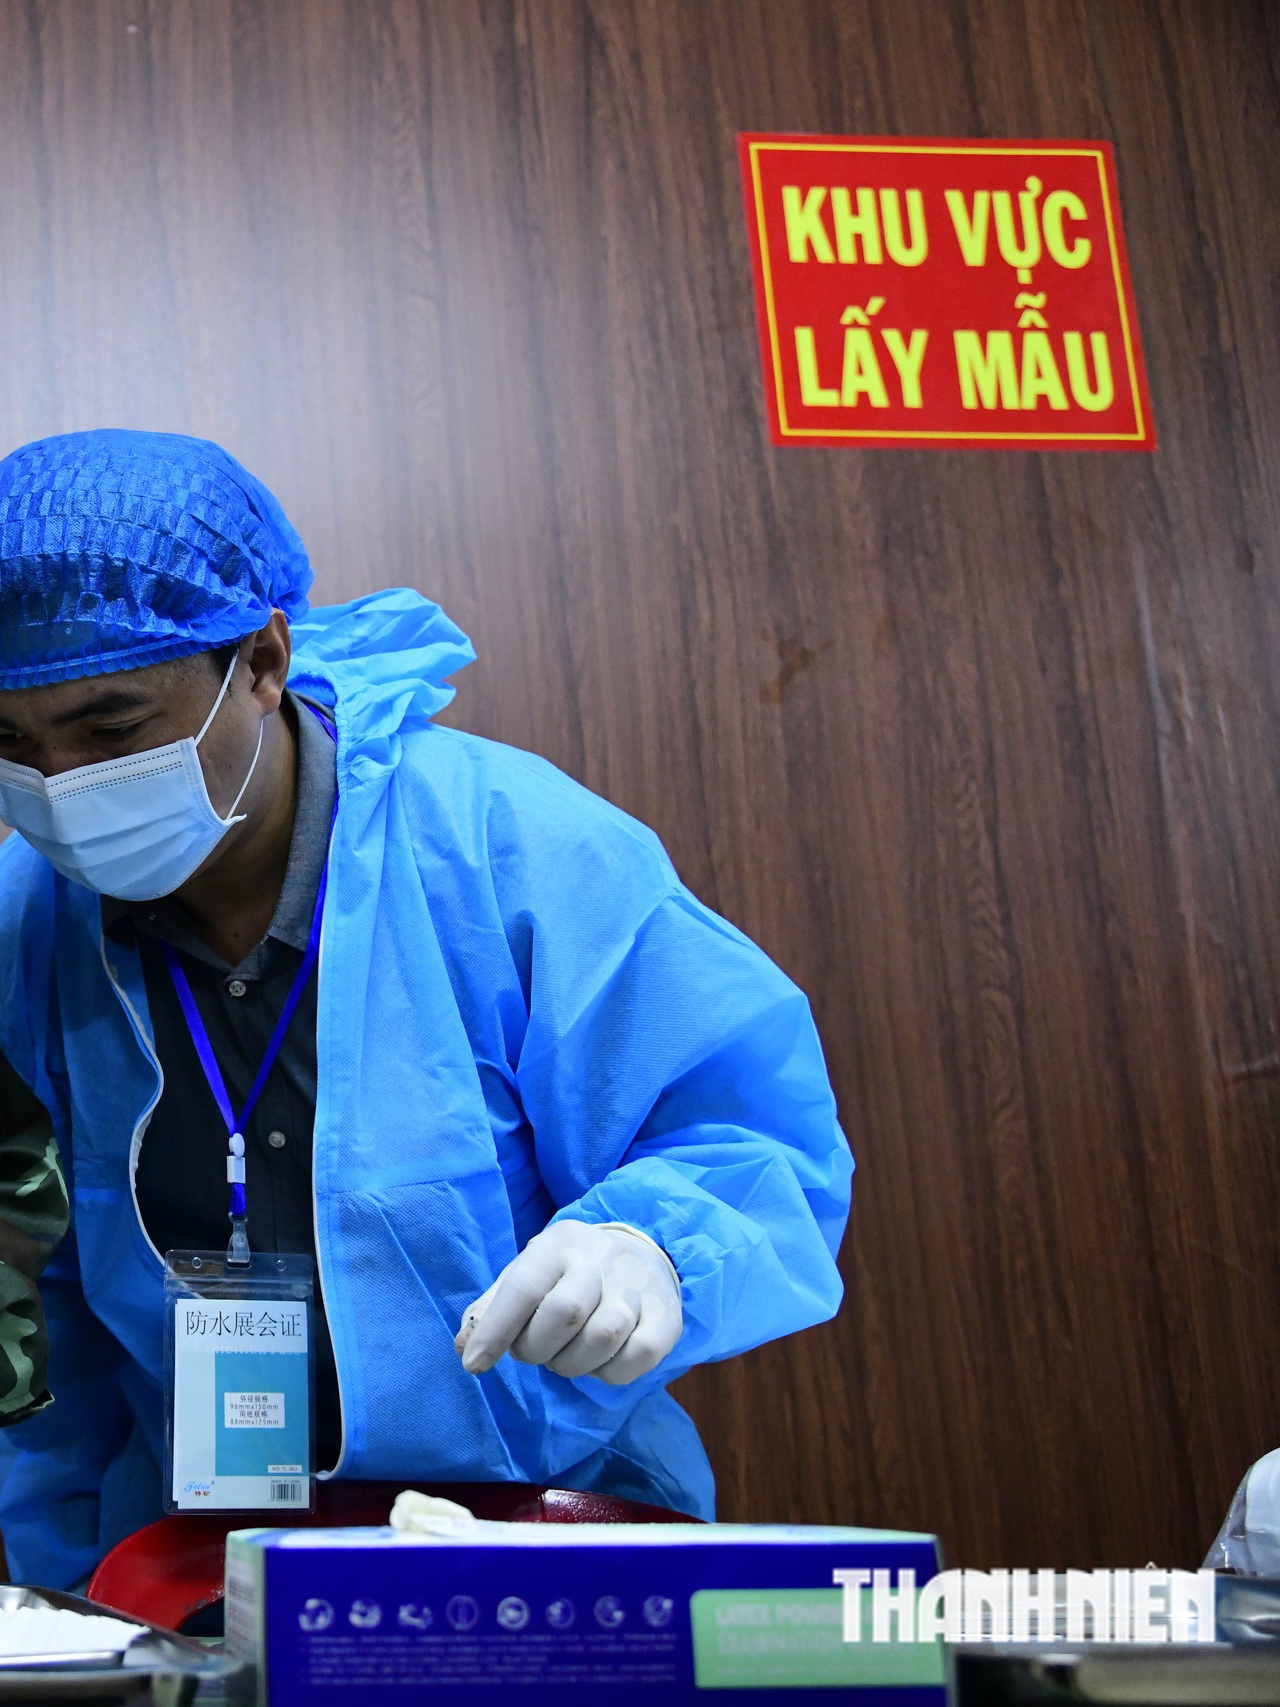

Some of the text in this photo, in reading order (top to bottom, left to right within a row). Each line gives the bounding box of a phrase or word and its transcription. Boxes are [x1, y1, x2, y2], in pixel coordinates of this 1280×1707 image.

[781, 175, 1092, 285] KHU VỰC
[793, 291, 1115, 412] LẤY MẪU
[186, 1310, 302, 1337] 防水展会证
